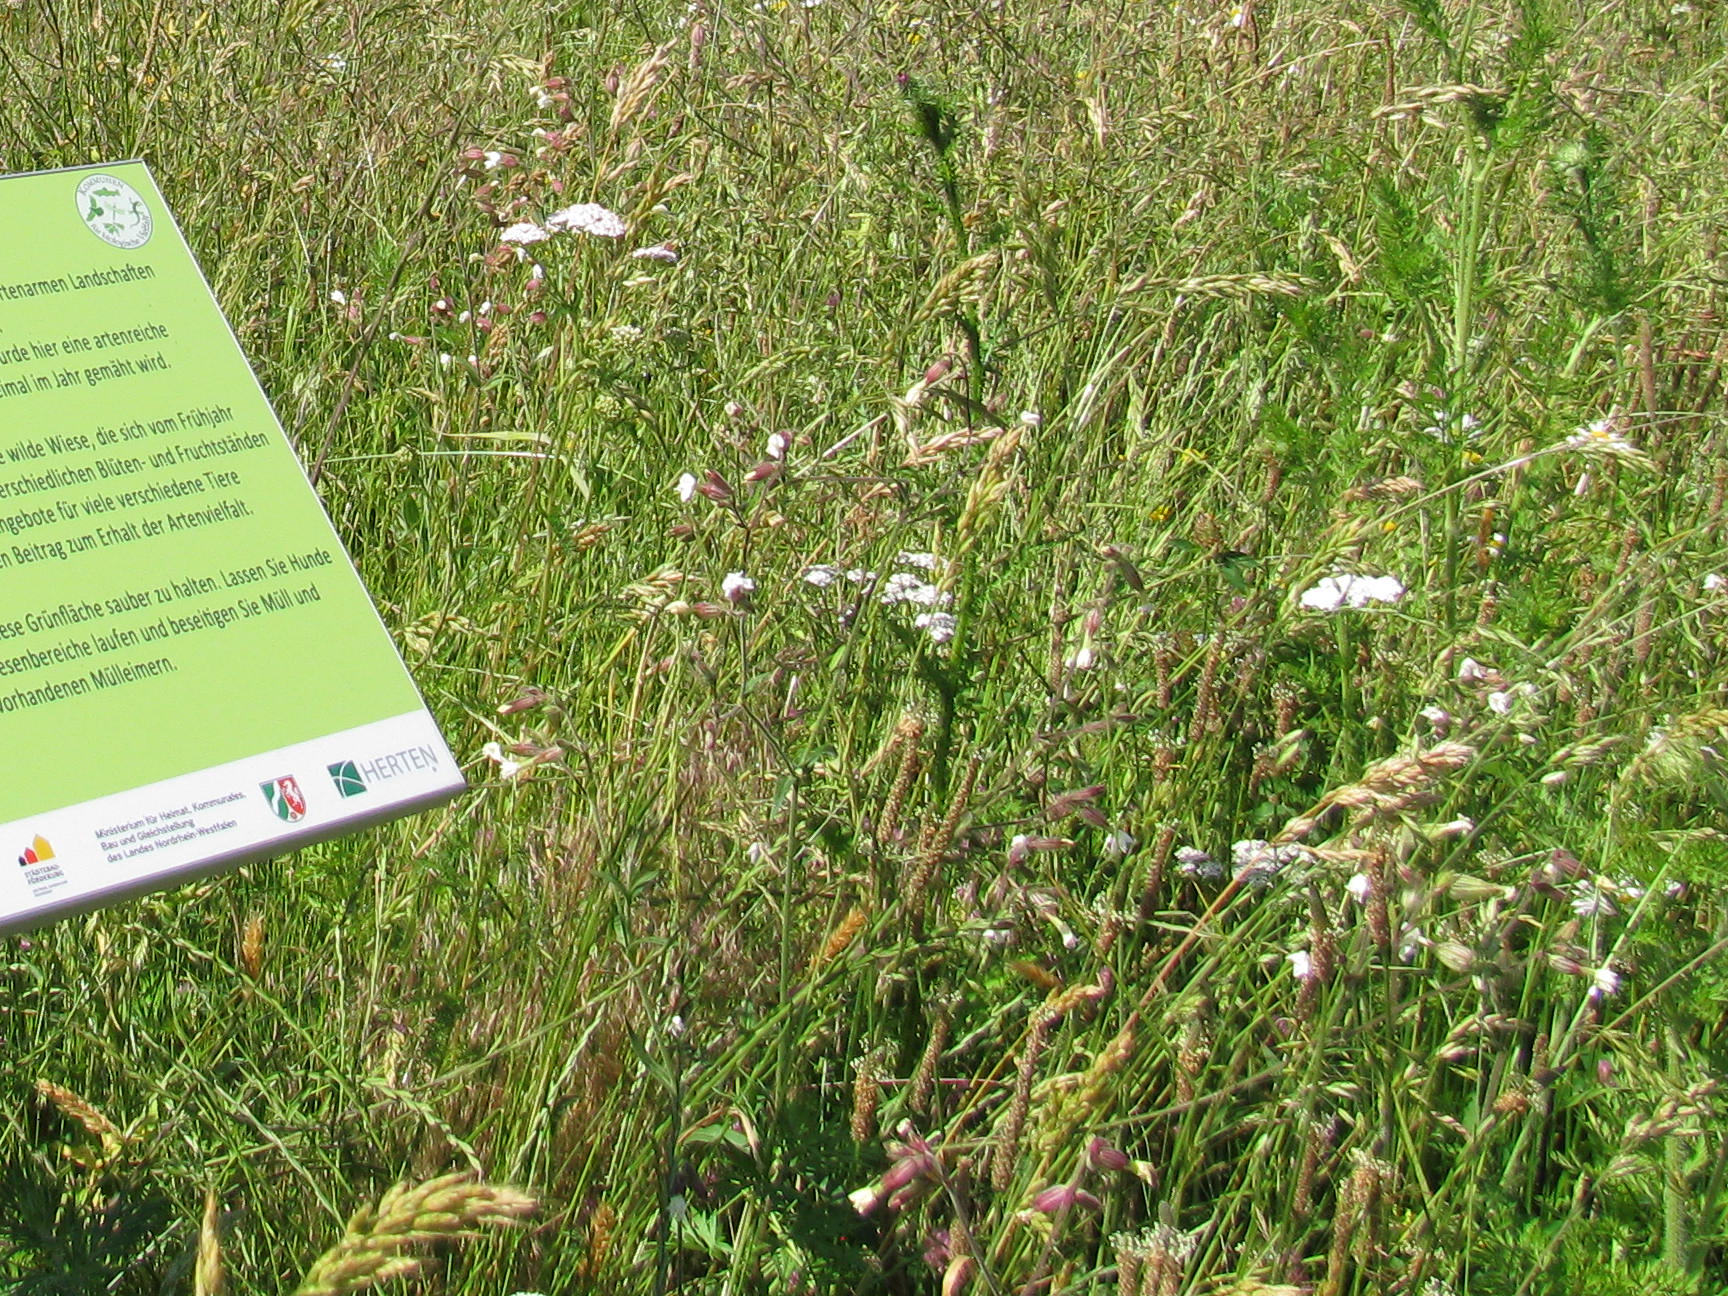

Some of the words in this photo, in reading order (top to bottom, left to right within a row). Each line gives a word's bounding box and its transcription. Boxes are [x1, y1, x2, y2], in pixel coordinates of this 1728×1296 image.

[68, 263, 156, 290] Landschaften
[29, 341, 60, 360] hier
[62, 336, 93, 355] eine
[93, 322, 170, 350] artenreiche
[30, 374, 53, 392] im
[52, 368, 82, 389] Jahr
[84, 359, 137, 387] gemäht
[135, 352, 172, 373] wird.
[6, 440, 47, 463] wilde
[44, 435, 97, 455] Wiese,
[96, 427, 119, 446] die
[120, 421, 148, 442] sich
[147, 418, 180, 436] vom
[177, 405, 234, 430] Frühjahr
[95, 458, 147, 479] Blüten-
[148, 447, 178, 469] und
[175, 432, 270, 464] Fruchtständen
[56, 501, 80, 521] für
[80, 493, 117, 516] viele
[116, 478, 206, 509] verschiedene
[202, 471, 241, 490] Tiere
[11, 542, 68, 565] Beitrag
[66, 535, 98, 554] zum
[96, 522, 142, 547] Erhalt
[142, 518, 165, 538] der
[167, 498, 254, 532] Artenvielfalt.
[25, 601, 105, 633] Grünfläche
[105, 591, 153, 615] sauber
[154, 588, 173, 604] zu
[170, 577, 223, 600] halten.
[220, 566, 268, 588] Lassen
[266, 558, 290, 578] Sie
[287, 548, 333, 573] Hunde
[91, 628, 140, 654] laufen
[139, 617, 170, 643] und
[166, 607, 240, 636] beseitigen
[238, 599, 262, 619] Sie
[260, 589, 294, 613] Müll
[293, 582, 322, 606] und
[89, 658, 178, 690] Mülleimern.
[361, 746, 439, 783] HERTEN
[95, 820, 146, 839] Ministerium
[146, 816, 158, 826] für
[101, 842, 119, 852] Bau
[120, 835, 137, 846] und
[137, 819, 196, 841] Gleichstellung
[107, 853, 124, 864] des
[124, 845, 155, 859] Landes
[155, 820, 238, 849] Nordrhein-Westfalen
